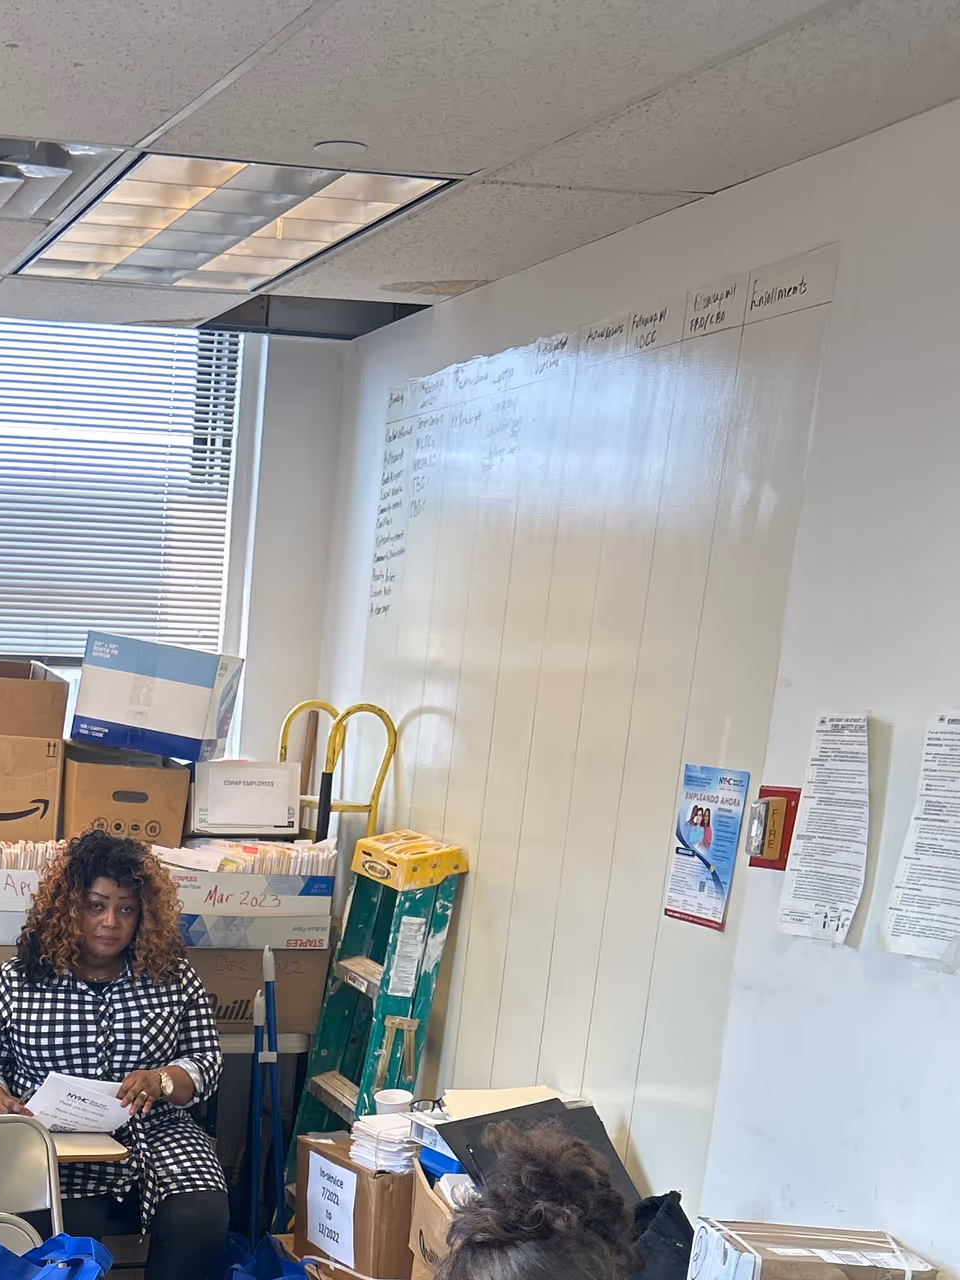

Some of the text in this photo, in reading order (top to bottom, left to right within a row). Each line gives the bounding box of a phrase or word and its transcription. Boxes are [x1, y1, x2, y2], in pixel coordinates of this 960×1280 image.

[685, 791, 741, 807] EMPLEANDO AHORA
[767, 808, 779, 850] FIRE
[204, 885, 282, 908] Mar 2023
[286, 938, 324, 948] STAPLES
[66, 1092, 90, 1104] NYHC
[319, 1165, 344, 1190] In-service
[325, 1209, 332, 1221] to
[318, 1222, 340, 1244] 12/2022
